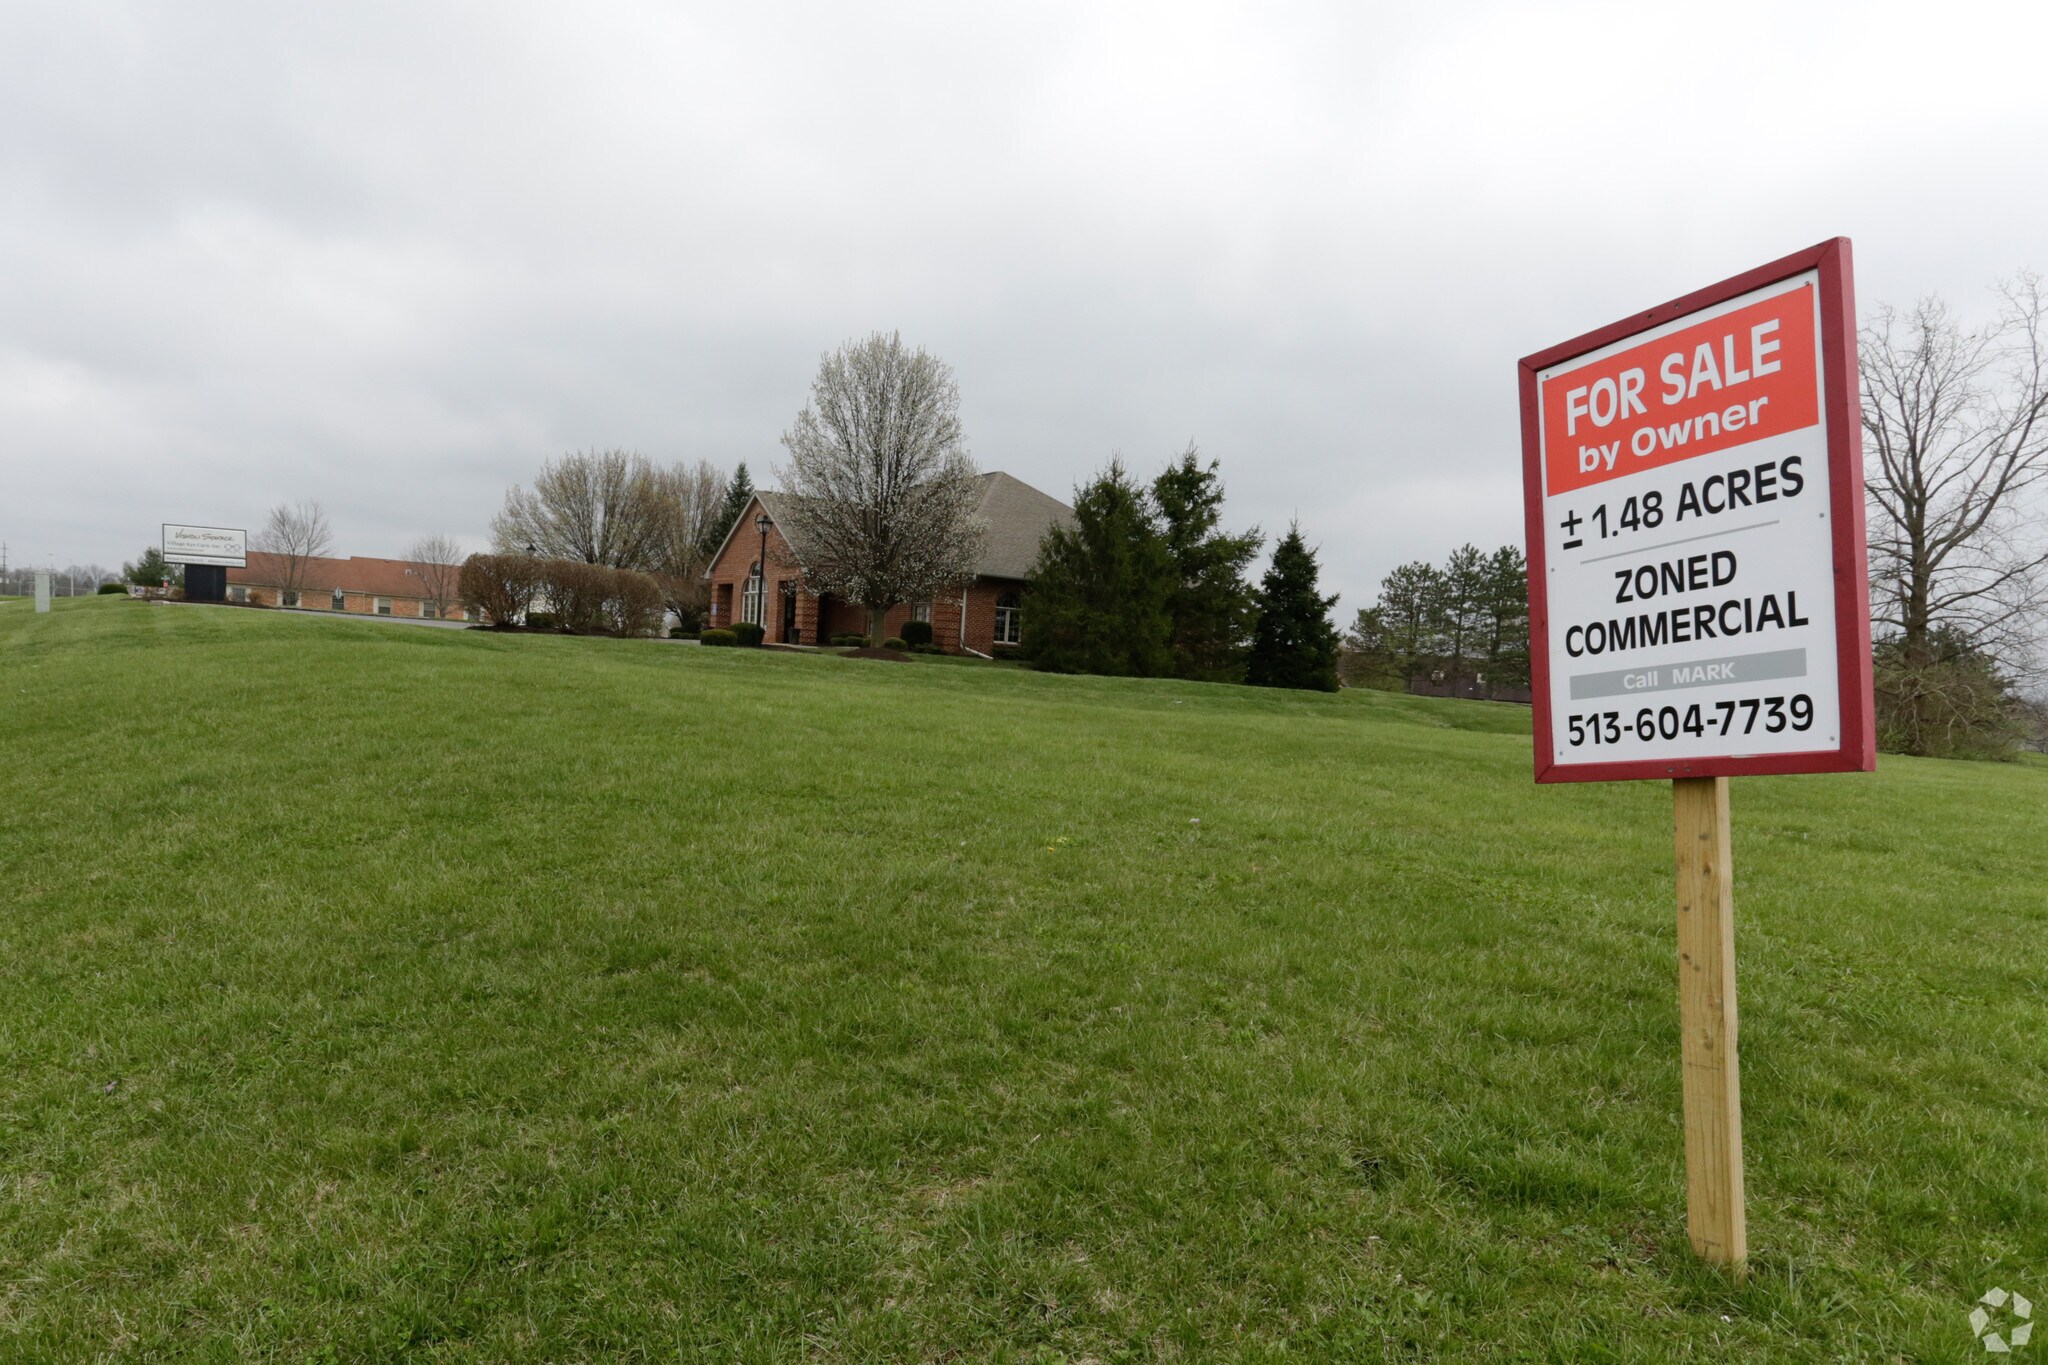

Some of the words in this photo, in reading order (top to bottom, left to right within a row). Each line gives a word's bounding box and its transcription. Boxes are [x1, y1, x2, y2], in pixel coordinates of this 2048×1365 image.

[1566, 367, 1648, 437] FOR
[1659, 318, 1782, 406] SALE
[1578, 440, 1621, 474] by
[1631, 396, 1769, 457] Owner
[1592, 490, 1664, 539] 1.48
[1675, 455, 1804, 522] ACRES
[1614, 550, 1737, 604] ZONED
[1565, 590, 1809, 658] COMMERCIAL
[1623, 670, 1658, 689] Call
[1673, 662, 1735, 684] MARK
[1568, 693, 1814, 747] 513-604-7739
